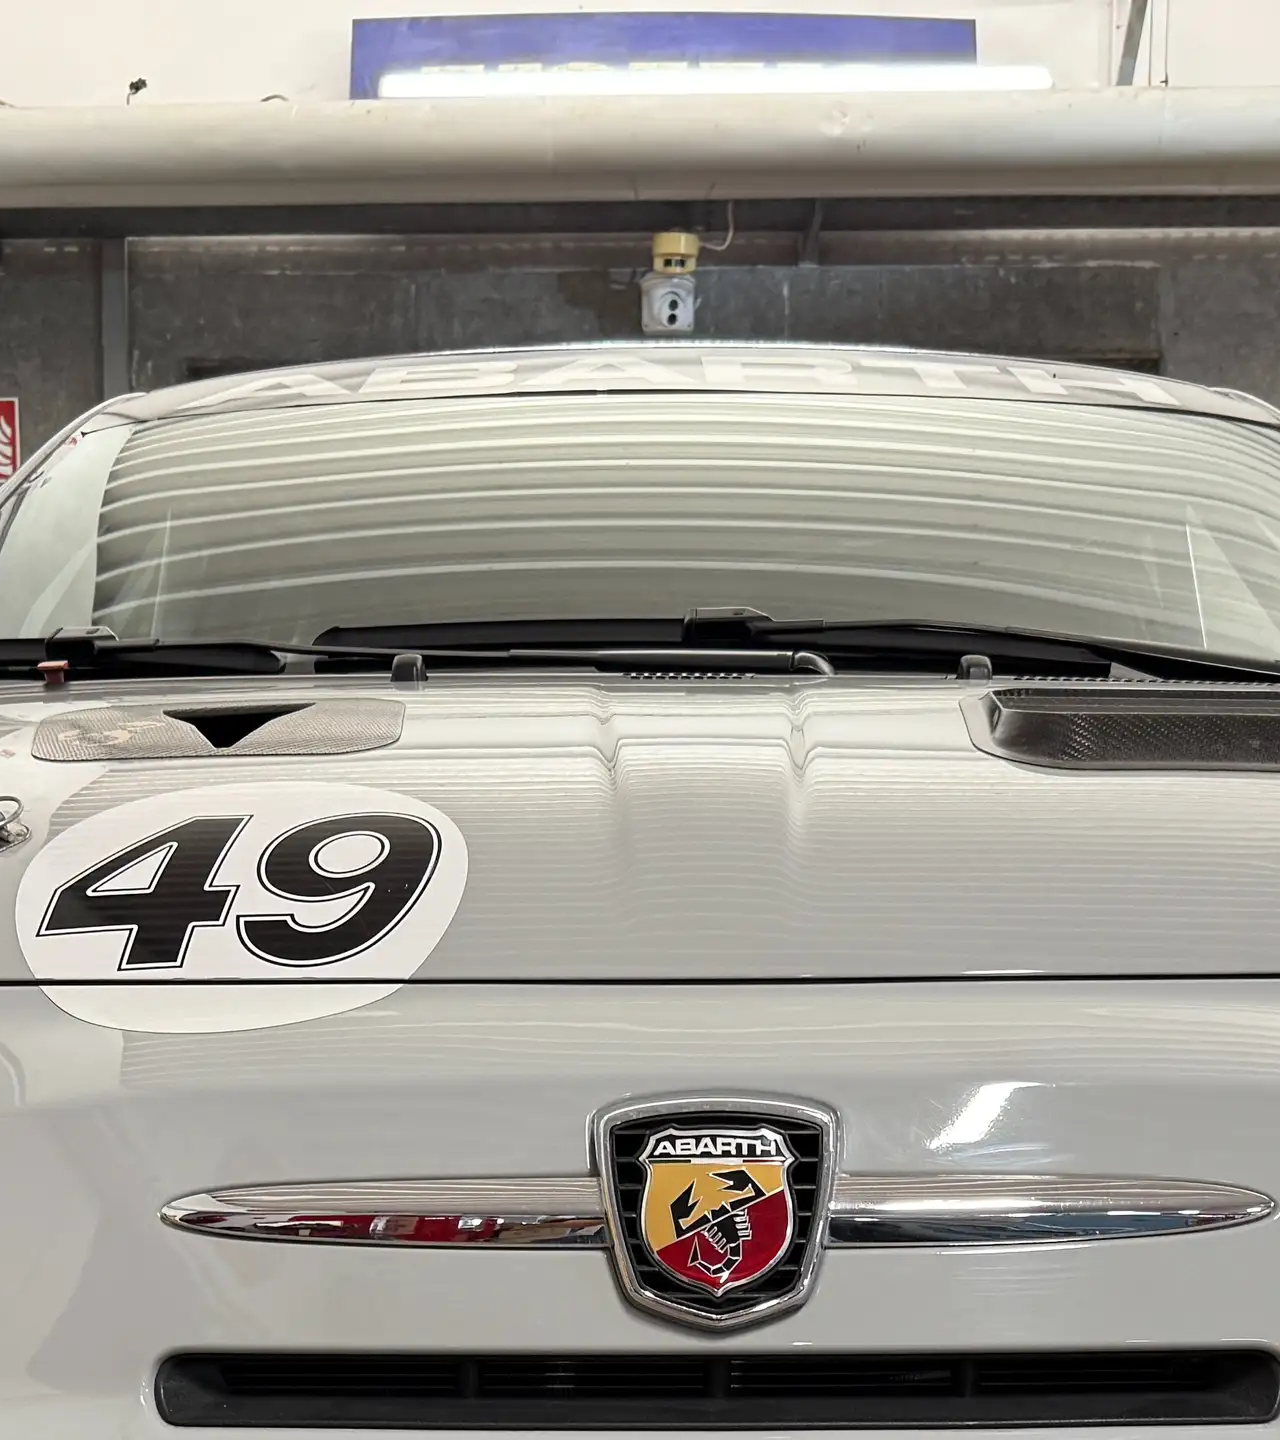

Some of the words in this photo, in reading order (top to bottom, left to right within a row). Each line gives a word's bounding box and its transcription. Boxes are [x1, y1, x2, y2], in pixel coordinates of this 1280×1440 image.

[173, 356, 1181, 409] ABARTH
[35, 812, 443, 972] 49
[653, 1136, 777, 1157] ABARTH
